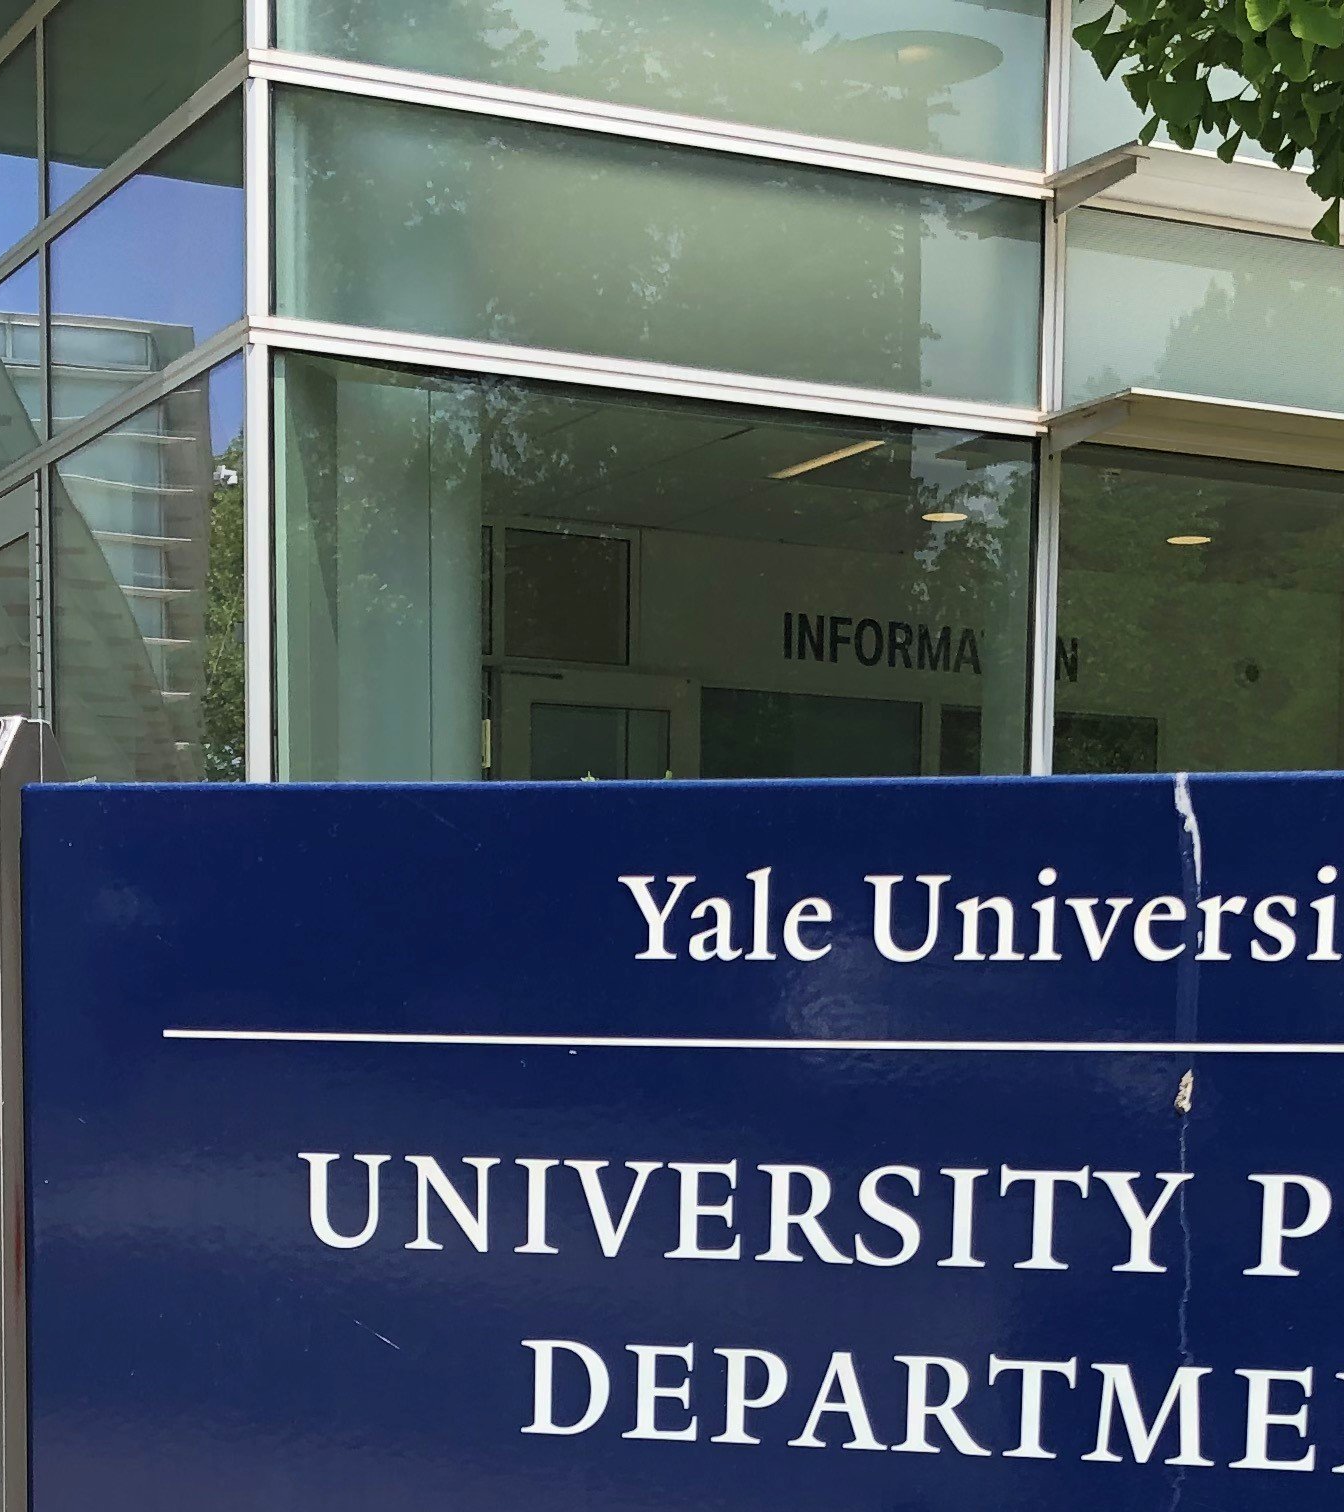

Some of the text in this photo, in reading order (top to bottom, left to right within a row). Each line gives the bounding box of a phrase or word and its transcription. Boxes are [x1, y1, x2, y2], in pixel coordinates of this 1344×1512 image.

[782, 610, 1079, 683] INFORMAN
[617, 866, 833, 962] Yale
[297, 1152, 1195, 1274] UNIVERSITY
